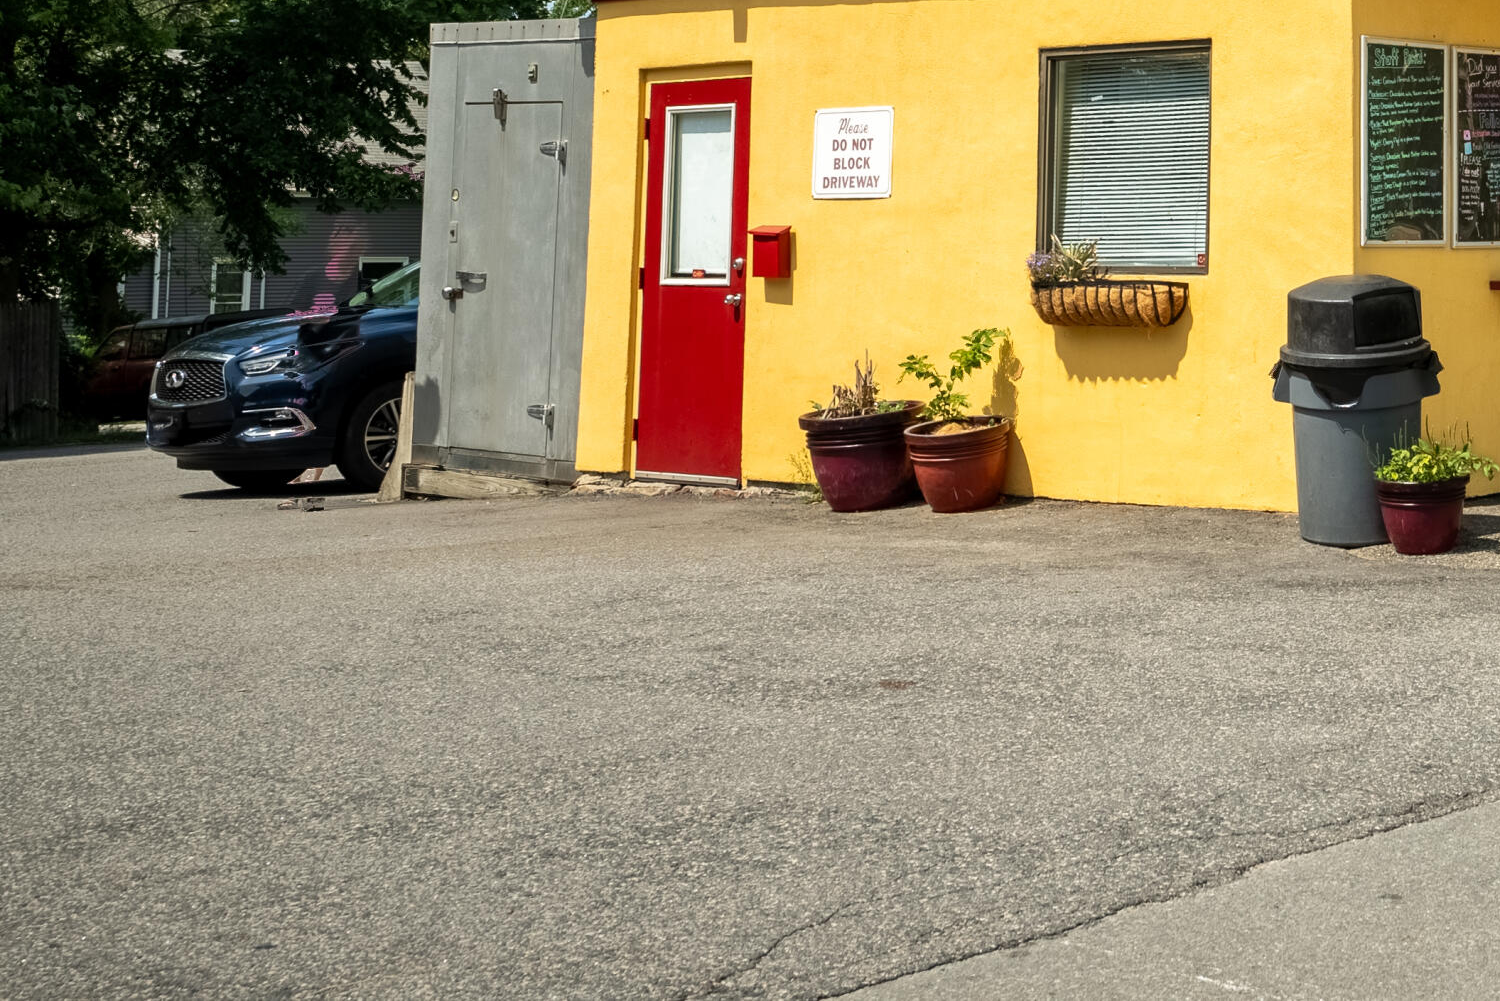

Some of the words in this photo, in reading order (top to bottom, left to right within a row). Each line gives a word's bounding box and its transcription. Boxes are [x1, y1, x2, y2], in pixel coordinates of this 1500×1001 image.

[1374, 47, 1399, 67] Staff
[1467, 57, 1484, 75] Did
[838, 117, 869, 135] Please
[832, 139, 848, 152] DO
[851, 138, 874, 151] NOT
[833, 156, 871, 170] BLOCK
[822, 175, 880, 189] DRIVEWAY
